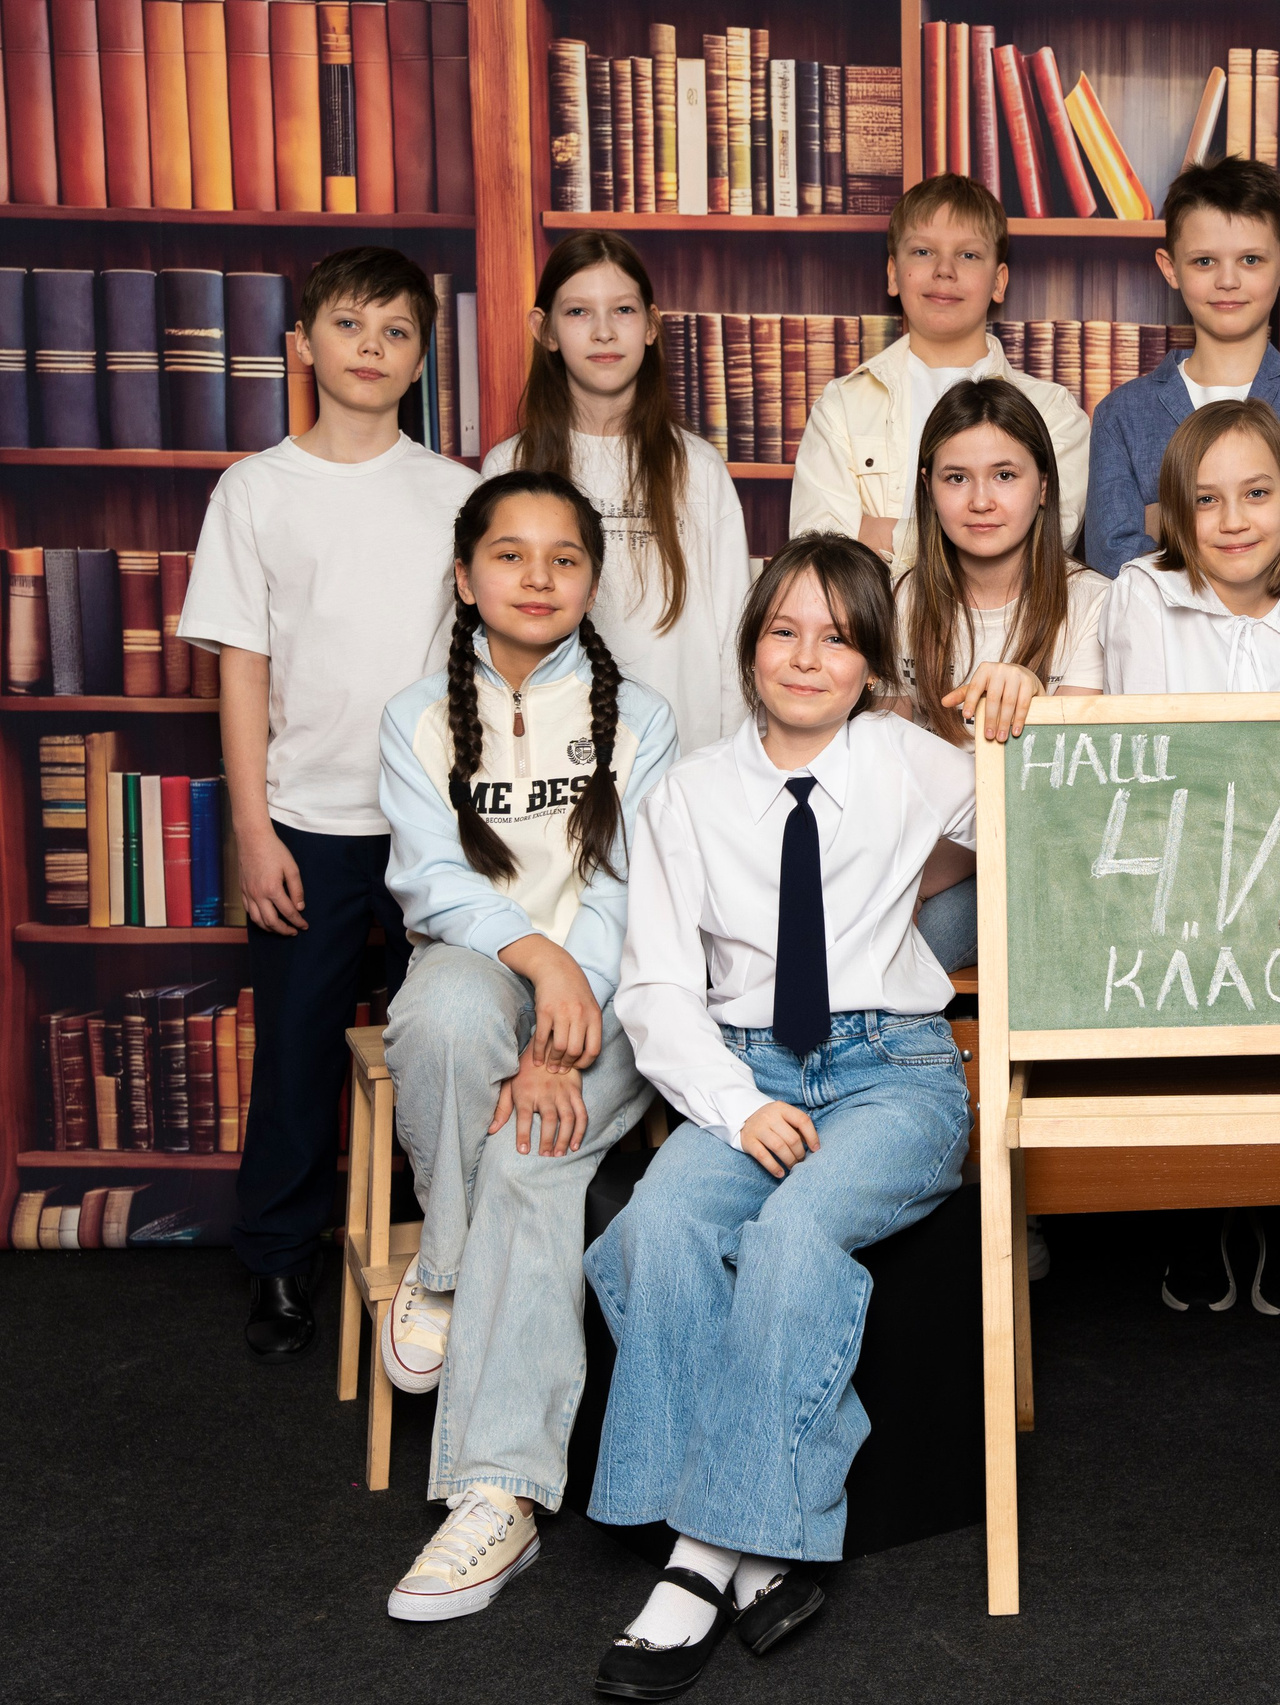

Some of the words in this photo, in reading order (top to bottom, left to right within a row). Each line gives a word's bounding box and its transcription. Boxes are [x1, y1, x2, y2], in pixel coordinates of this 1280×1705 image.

[1021, 733, 1177, 790] НАШ
[526, 770, 617, 814] BES
[514, 815, 532, 823] MORE
[532, 808, 567, 820] EXCELLENT
